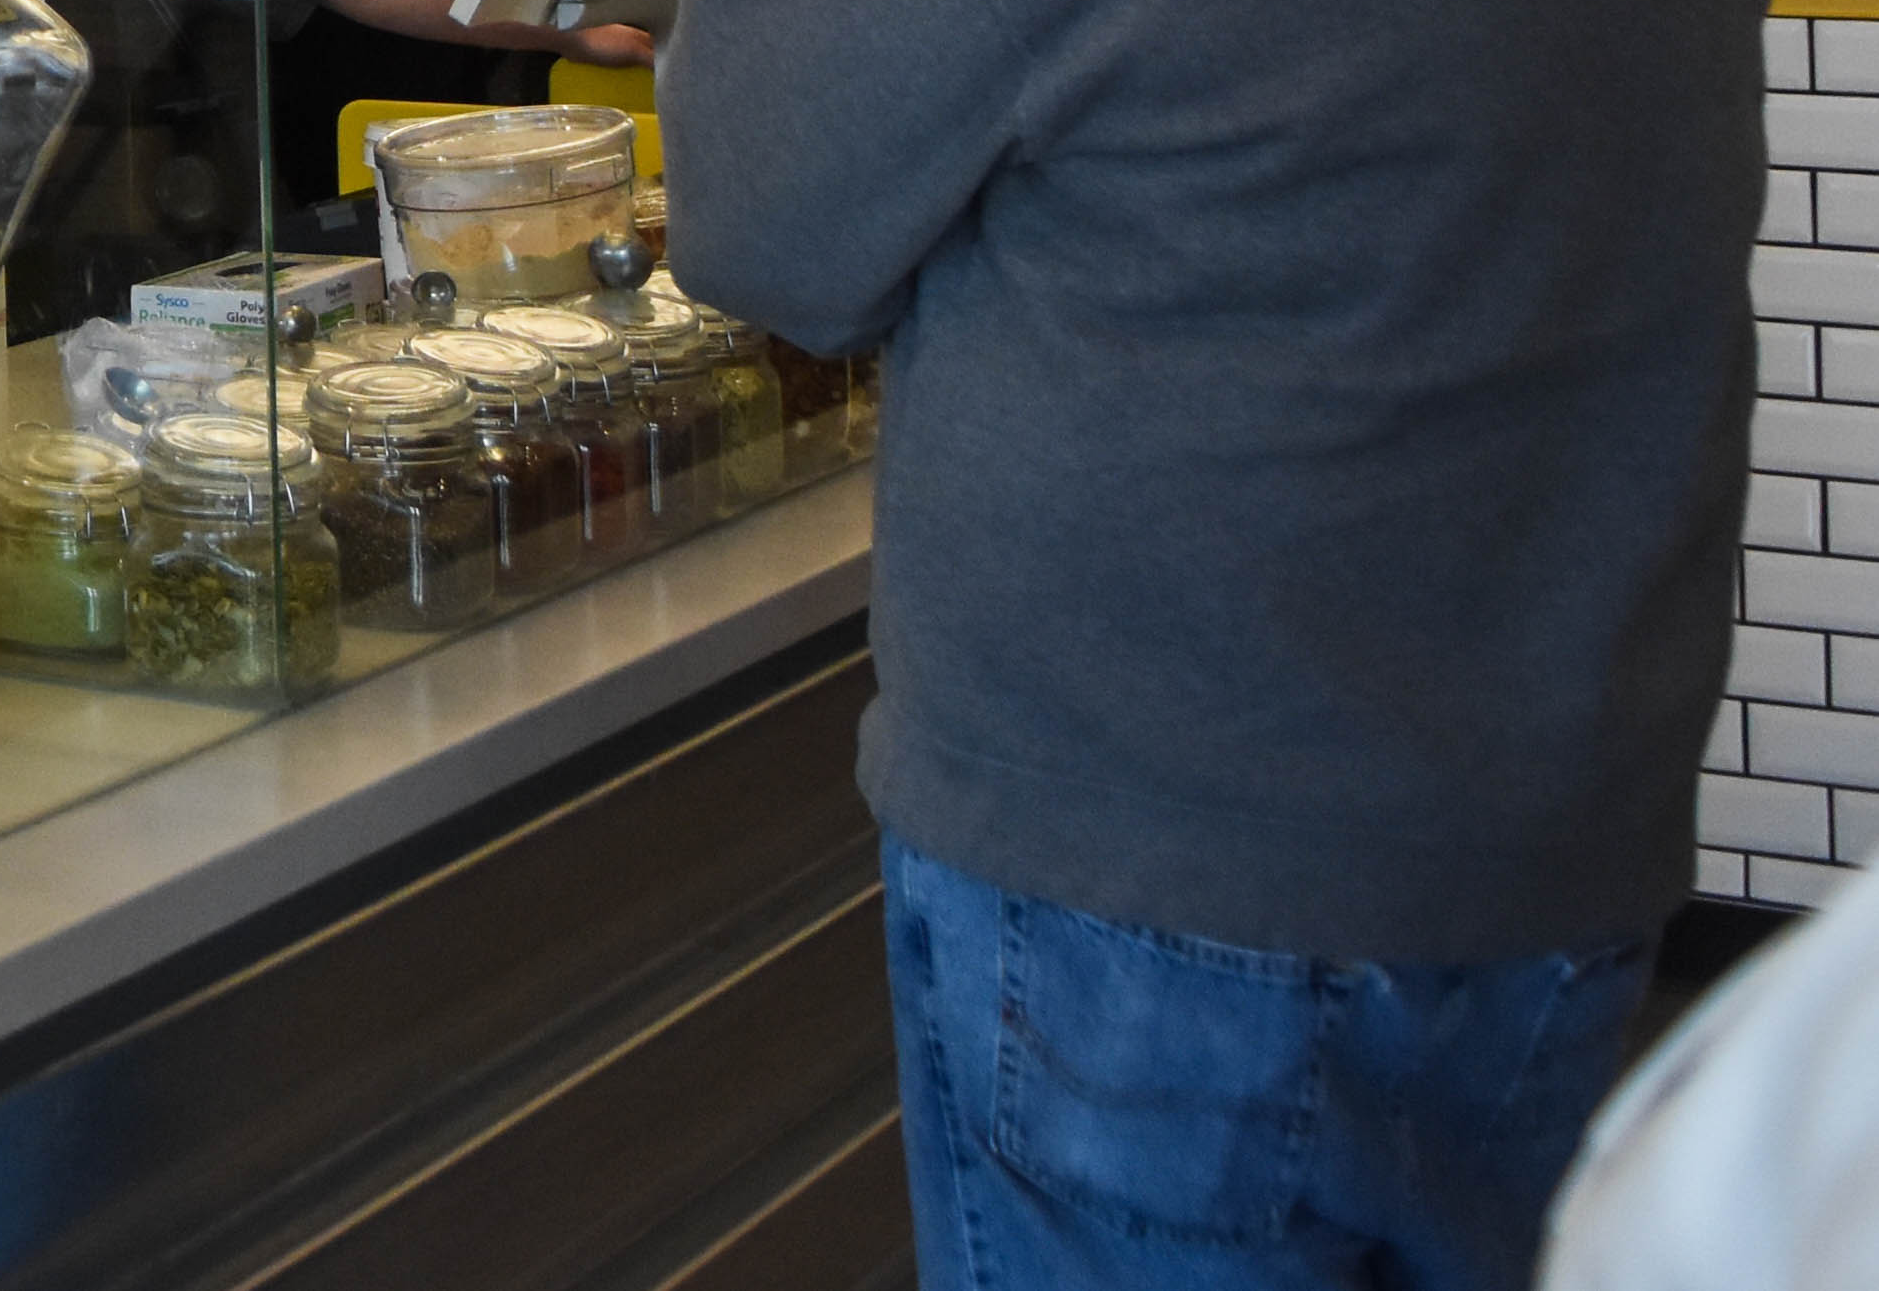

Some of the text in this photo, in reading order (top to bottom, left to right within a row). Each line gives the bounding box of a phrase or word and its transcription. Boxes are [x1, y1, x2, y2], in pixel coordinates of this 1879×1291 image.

[155, 293, 189, 308] Sysco
[240, 300, 265, 315] Poly
[226, 311, 266, 325] Gloves
